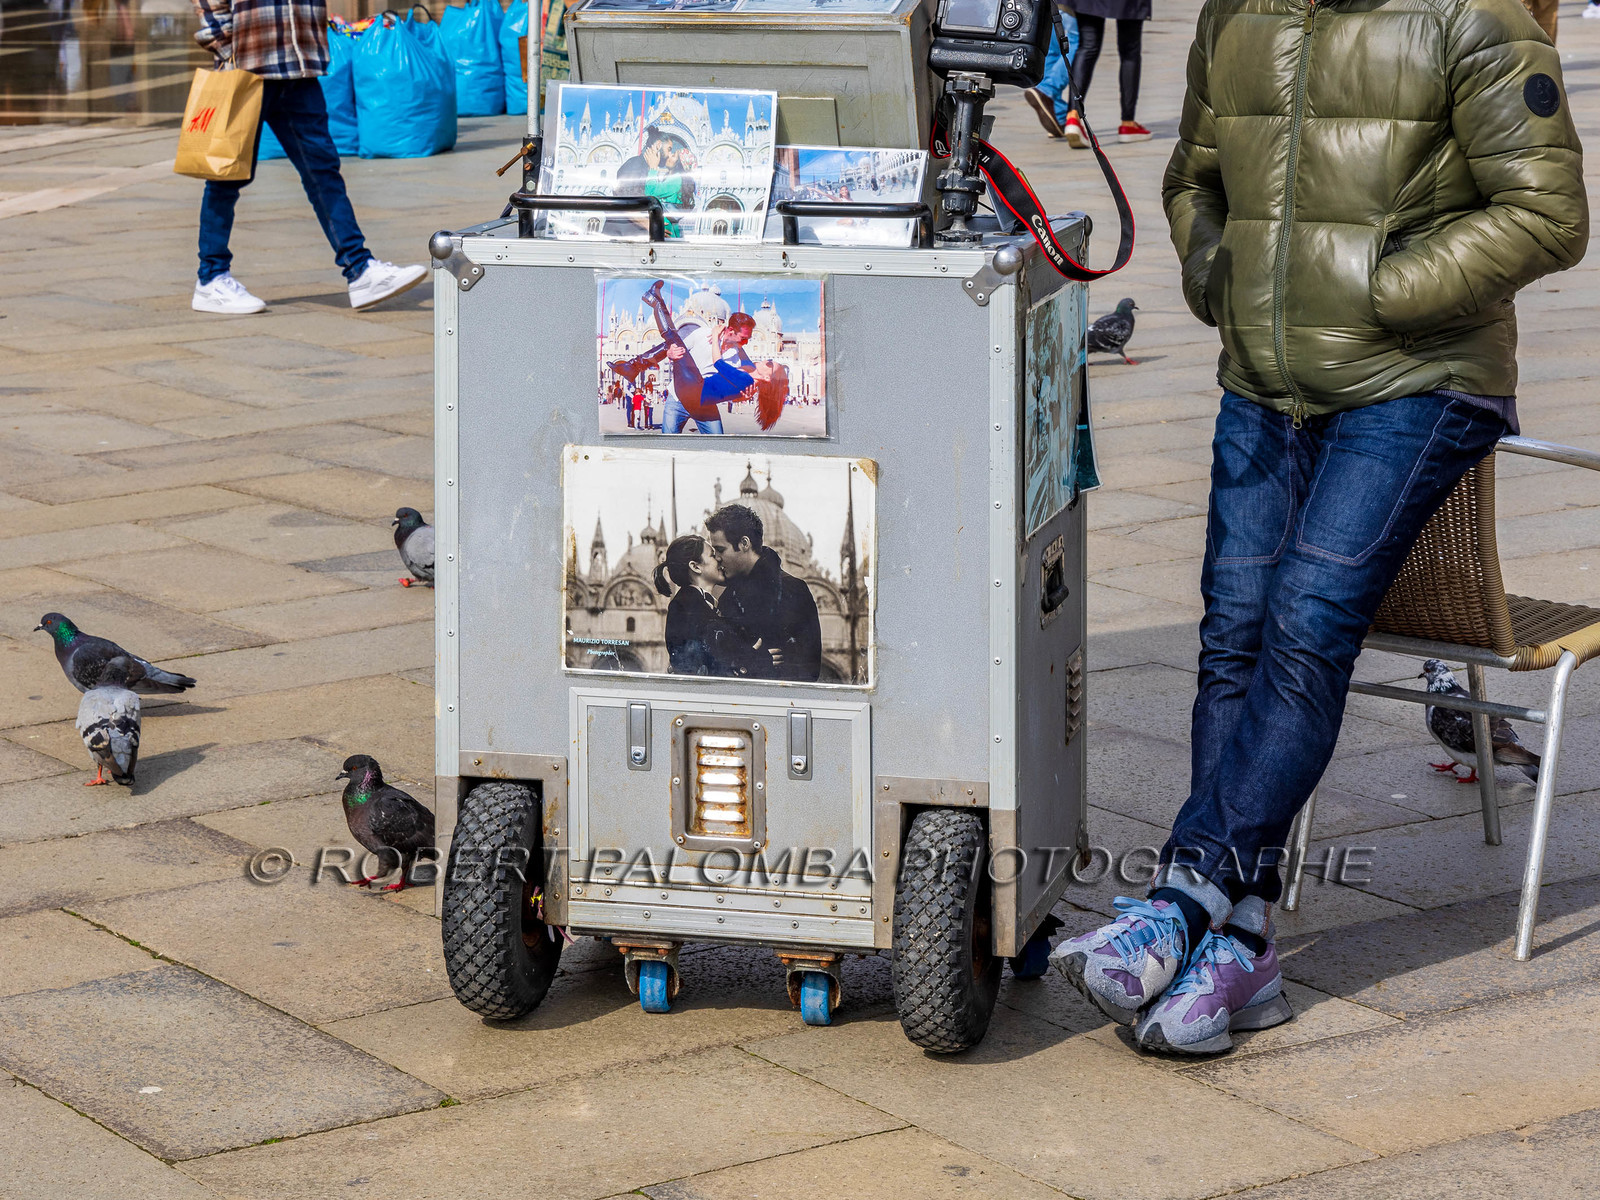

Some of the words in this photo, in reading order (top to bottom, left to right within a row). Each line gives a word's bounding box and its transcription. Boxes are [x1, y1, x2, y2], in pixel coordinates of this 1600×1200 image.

[1031, 214, 1064, 266] Canon
[573, 637, 600, 645] MAURIZIO
[601, 639, 630, 647] TORRESAN
